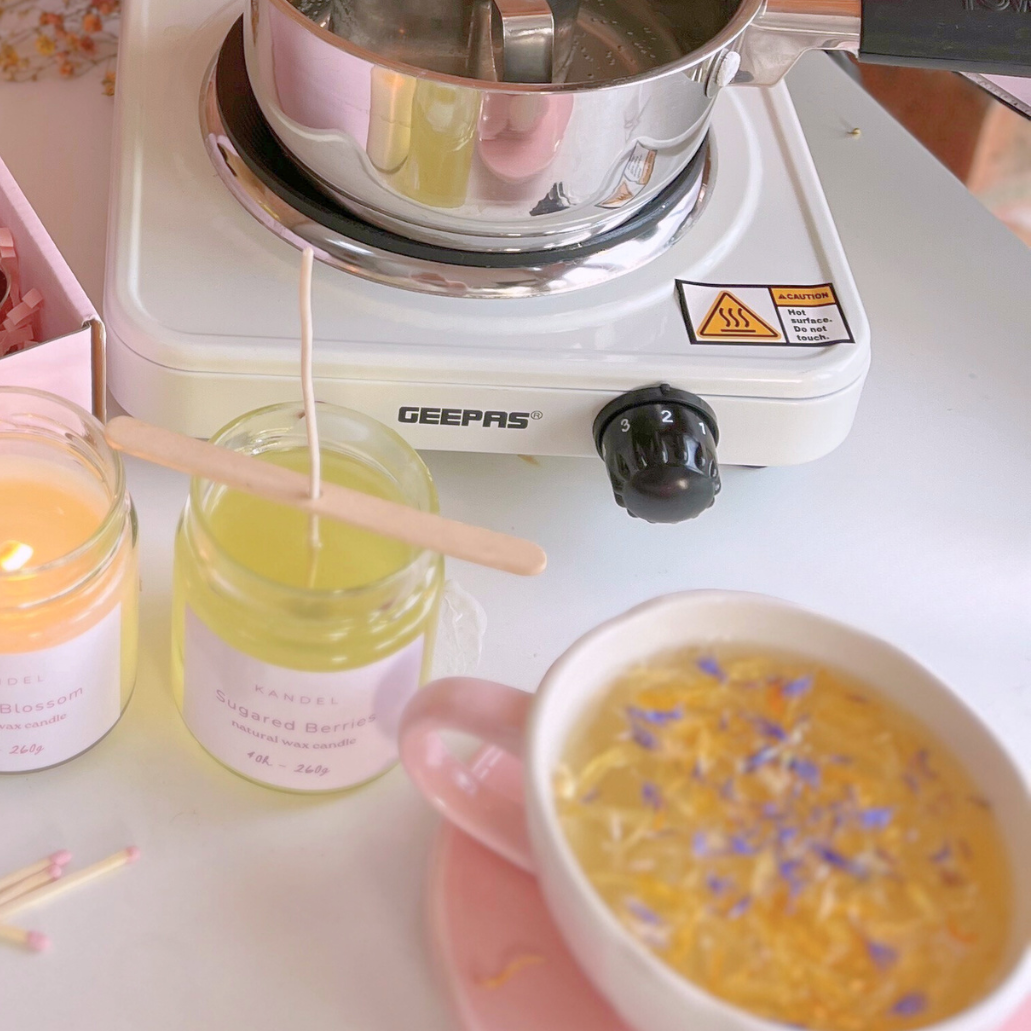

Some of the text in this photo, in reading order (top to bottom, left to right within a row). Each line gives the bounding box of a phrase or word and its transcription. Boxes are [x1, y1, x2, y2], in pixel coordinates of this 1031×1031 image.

[786, 291, 829, 300] CAUTION
[793, 325, 828, 333] Do not
[620, 409, 706, 435] 3 2 1
[0, 686, 84, 715] Blossom
[255, 684, 339, 706] KANDEL
[24, 712, 67, 730] candle
[215, 689, 377, 734] Sugared Berries
[231, 719, 357, 750] natural wax candle
[9, 743, 45, 756] 260g
[293, 763, 331, 777] 260g
